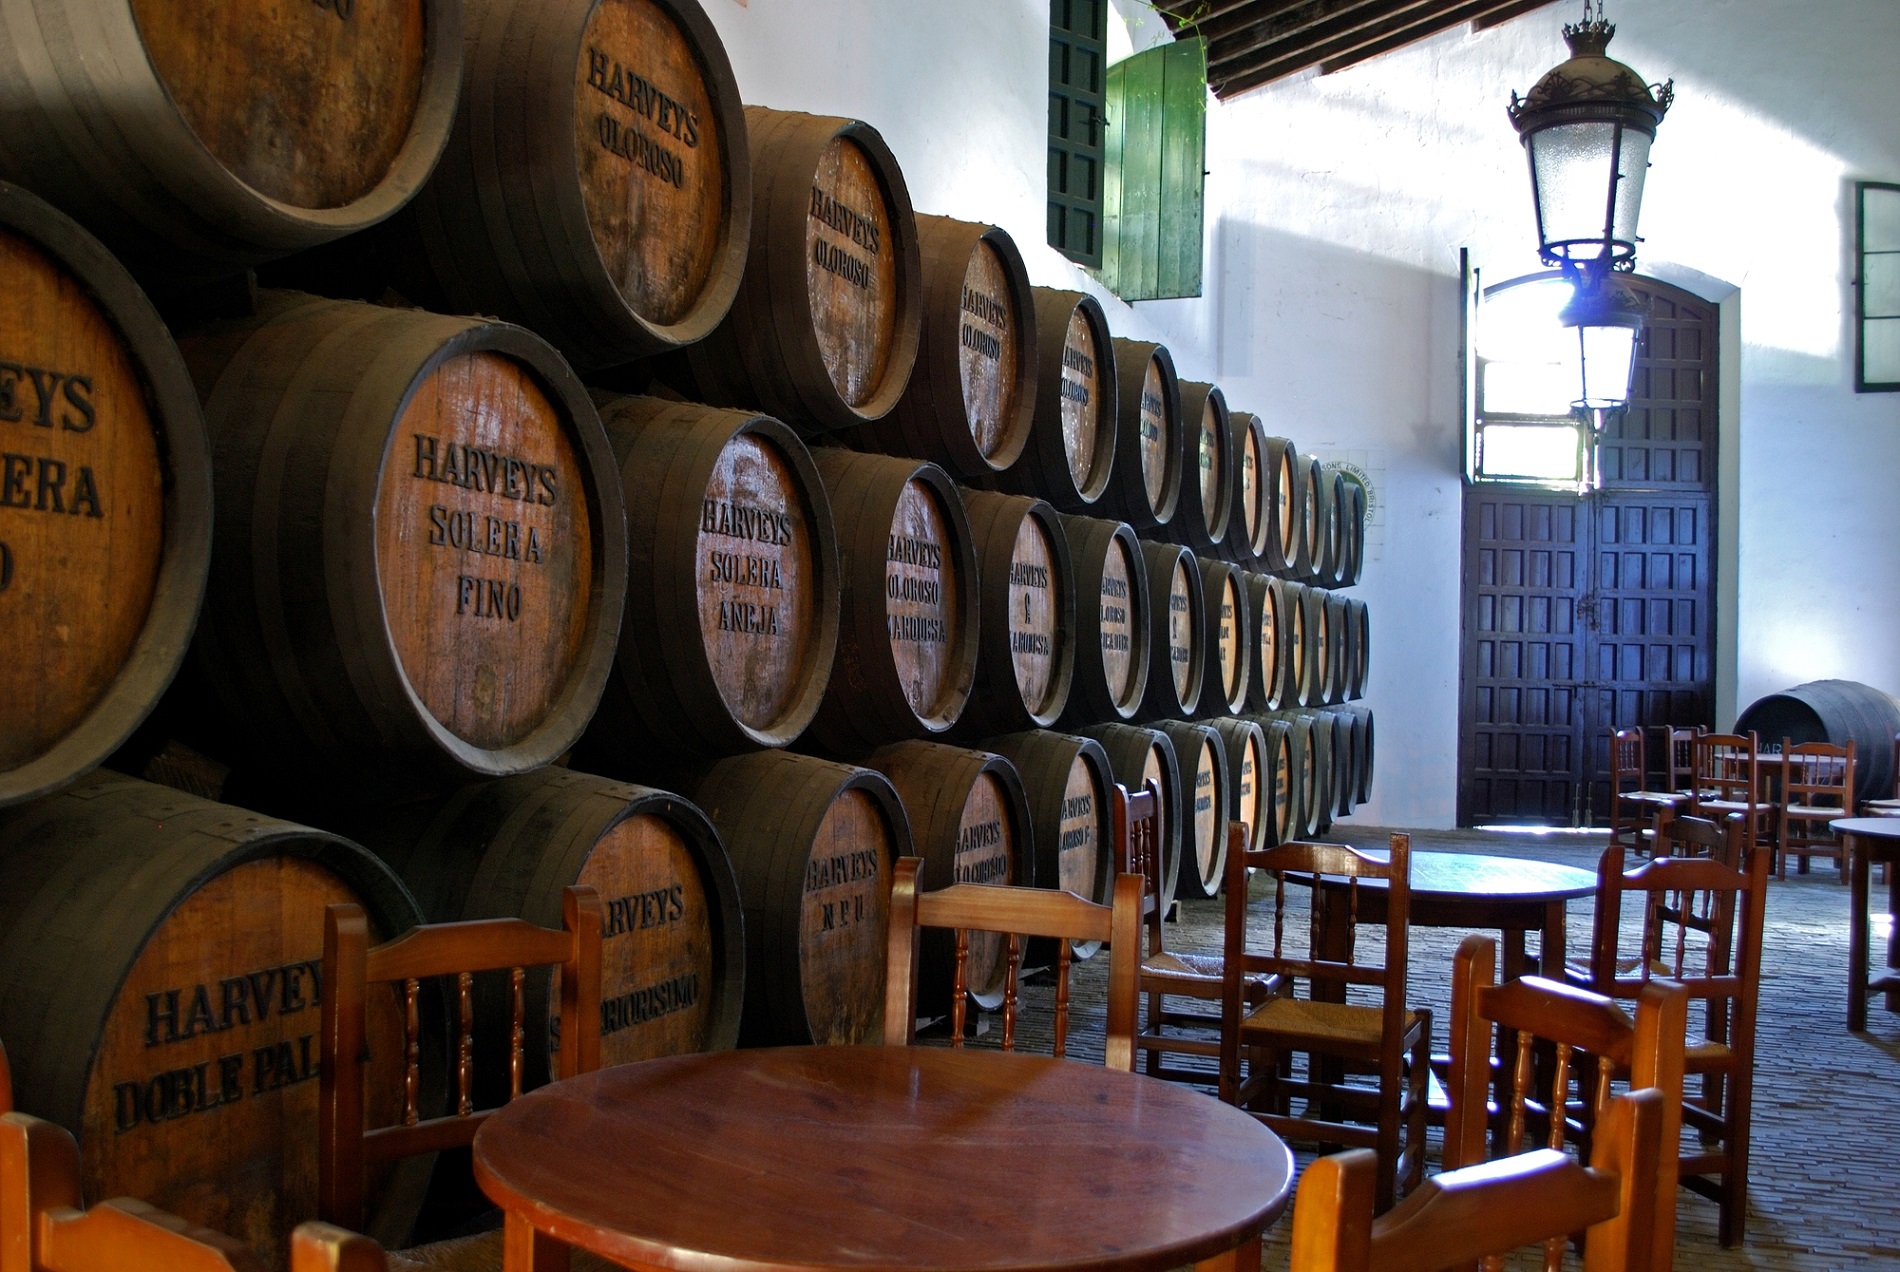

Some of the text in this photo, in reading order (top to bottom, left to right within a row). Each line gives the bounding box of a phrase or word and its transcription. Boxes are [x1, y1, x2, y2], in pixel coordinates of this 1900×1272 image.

[587, 47, 699, 148] HARVEYS
[599, 112, 684, 188] OLOROSO
[811, 186, 879, 255] HARVEYS
[816, 238, 869, 290] OLOROSO
[961, 283, 1006, 330] HARVEYS
[963, 323, 1000, 361] OLOROSO
[413, 433, 558, 508] HARVEYS
[1346, 464, 1370, 487] LIMITED
[1365, 490, 1375, 522] BRISTOL
[429, 504, 544, 564] SOLERA
[702, 499, 792, 546] HARVEYS
[710, 551, 784, 589] SOLERA
[887, 534, 941, 569] HARVEYS
[456, 575, 523, 621] FINO
[888, 574, 939, 605] OLOROSO
[1102, 577, 1126, 599] ARVEYS
[719, 601, 780, 635] ANEJA
[1061, 795, 1091, 820] ARVEYS
[806, 848, 877, 892] HARVEYS
[113, 1053, 243, 1135] DOBLE
